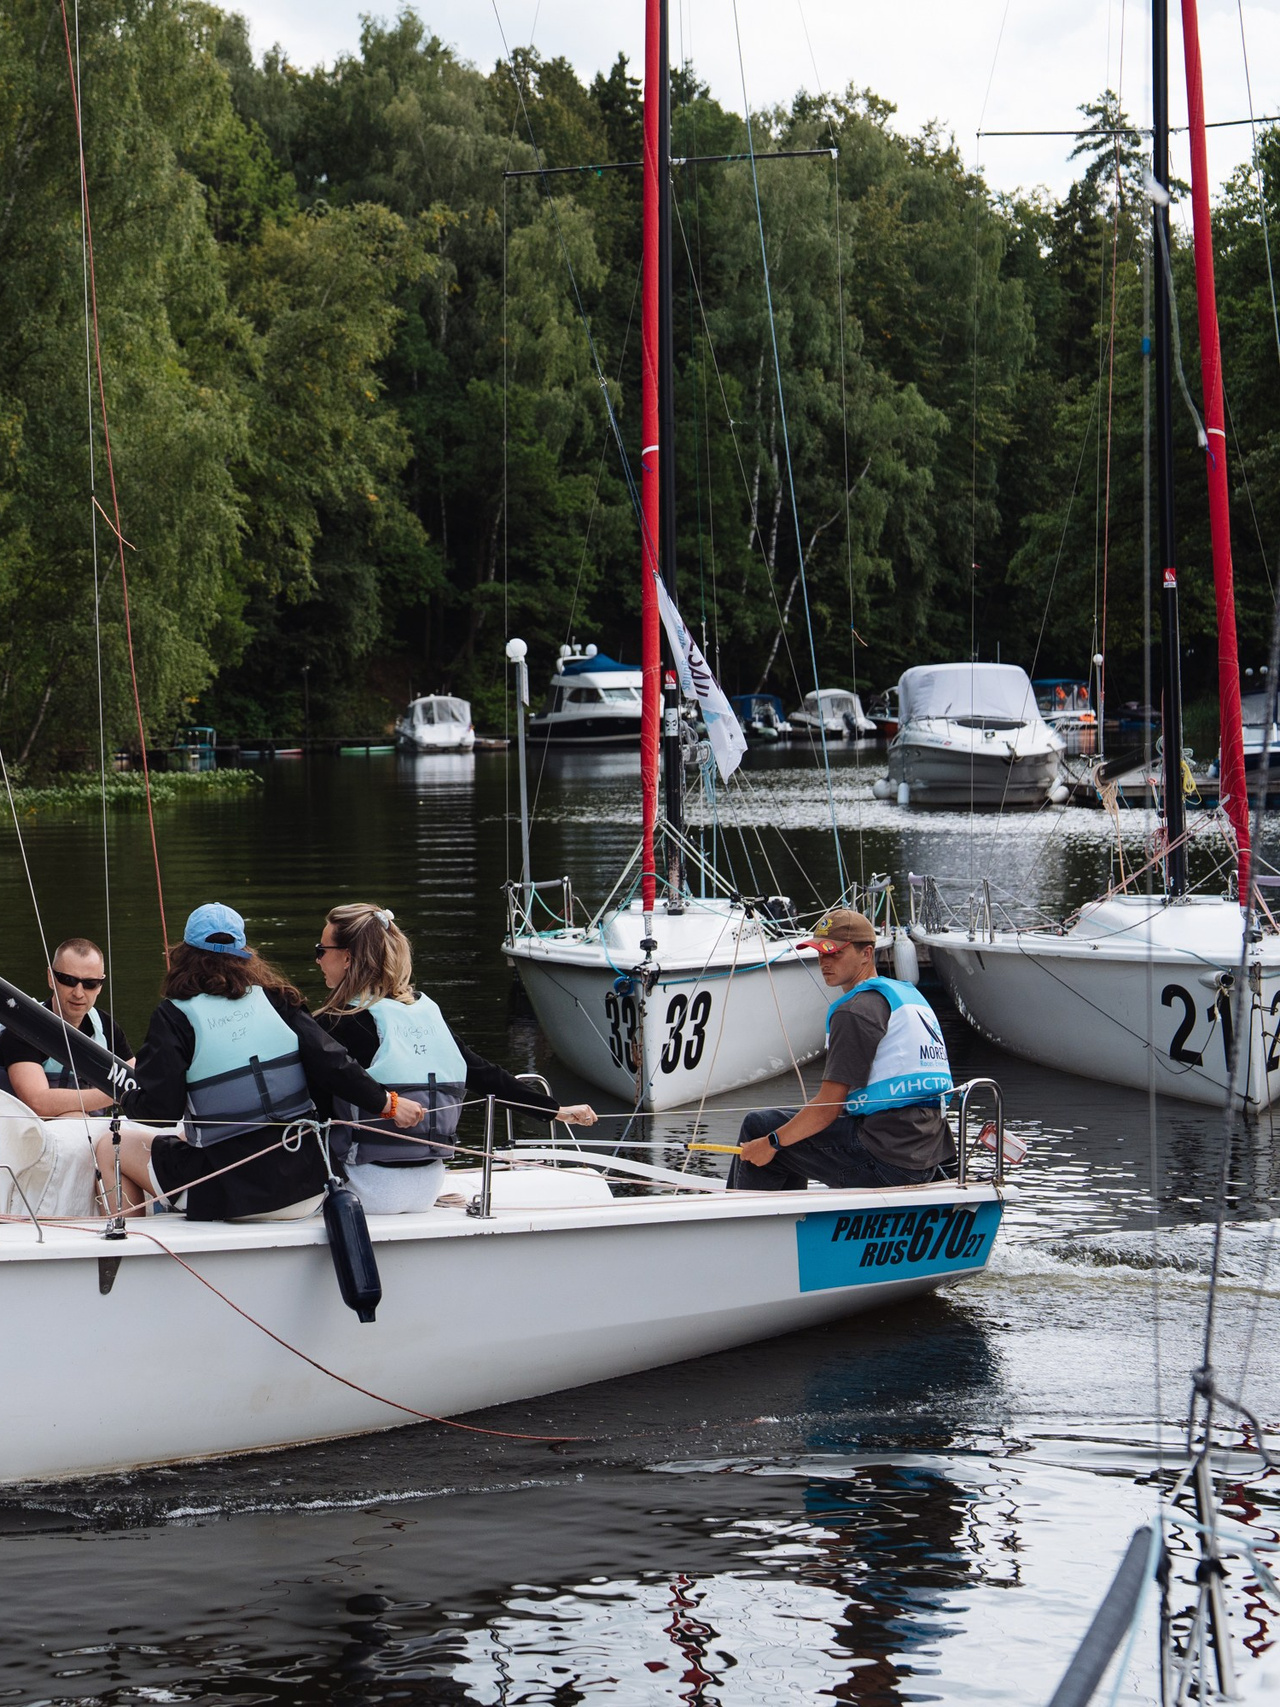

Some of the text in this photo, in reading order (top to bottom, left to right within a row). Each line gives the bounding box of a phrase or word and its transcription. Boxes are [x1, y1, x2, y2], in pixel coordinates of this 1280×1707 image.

[231, 1026, 247, 1042] 27
[661, 991, 712, 1074] 33
[413, 1043, 427, 1056] 27
[858, 1239, 909, 1268] RUS
[962, 1233, 987, 1258] 27
